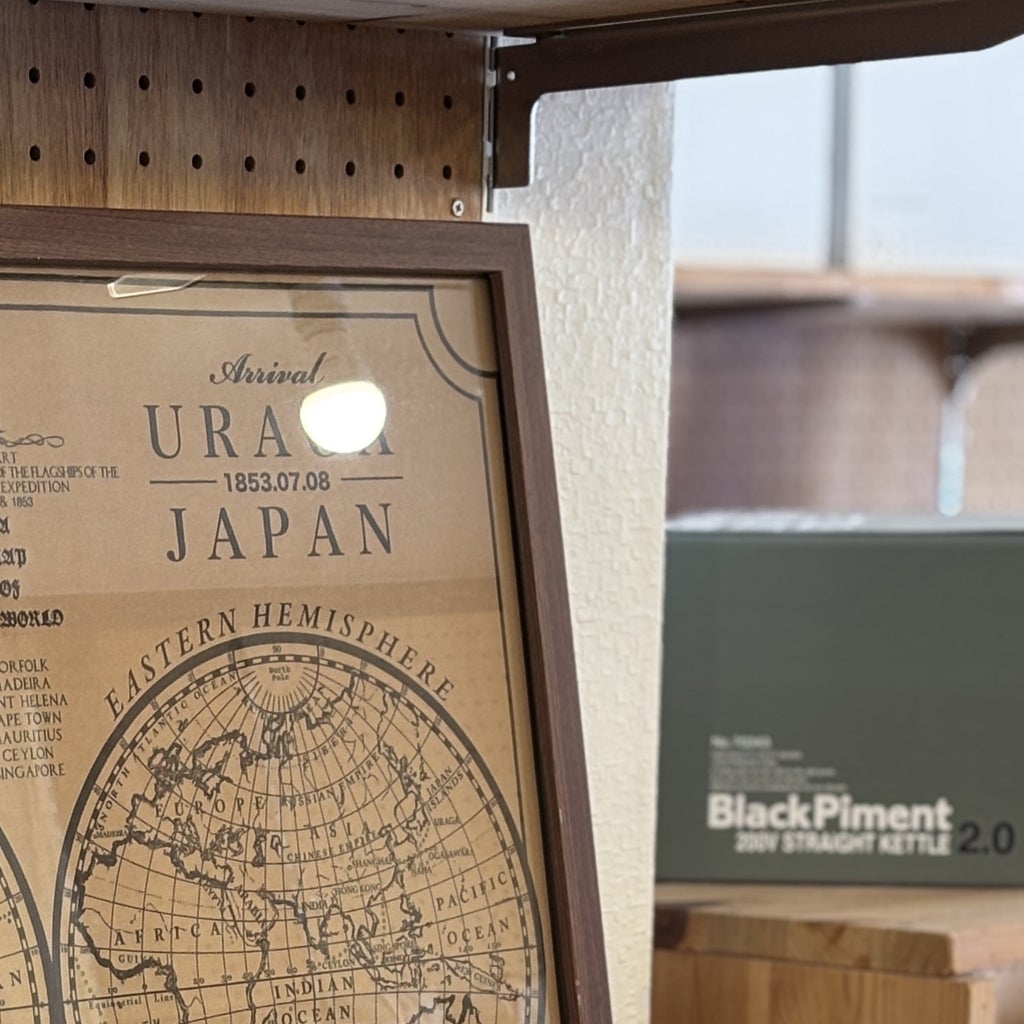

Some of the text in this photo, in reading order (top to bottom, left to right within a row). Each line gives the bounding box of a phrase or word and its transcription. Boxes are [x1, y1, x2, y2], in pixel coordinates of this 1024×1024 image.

[209, 352, 327, 385] Arrival
[143, 403, 395, 459] URA
[0, 480, 70, 494] EXPEDITION
[223, 472, 331, 493] 1853.07.08
[0, 497, 8, 508] &
[12, 496, 34, 508] 1853
[166, 503, 393, 562] JAPAN
[0, 608, 64, 628] WORLD
[104, 602, 455, 721] EASTERN HEMISPHERE
[20, 693, 68, 708] HELENA
[24, 711, 62, 726] TOWN
[2, 747, 54, 762] CEYLON
[878, 834, 952, 856] KETTLE
[959, 821, 1016, 856] 2.0
